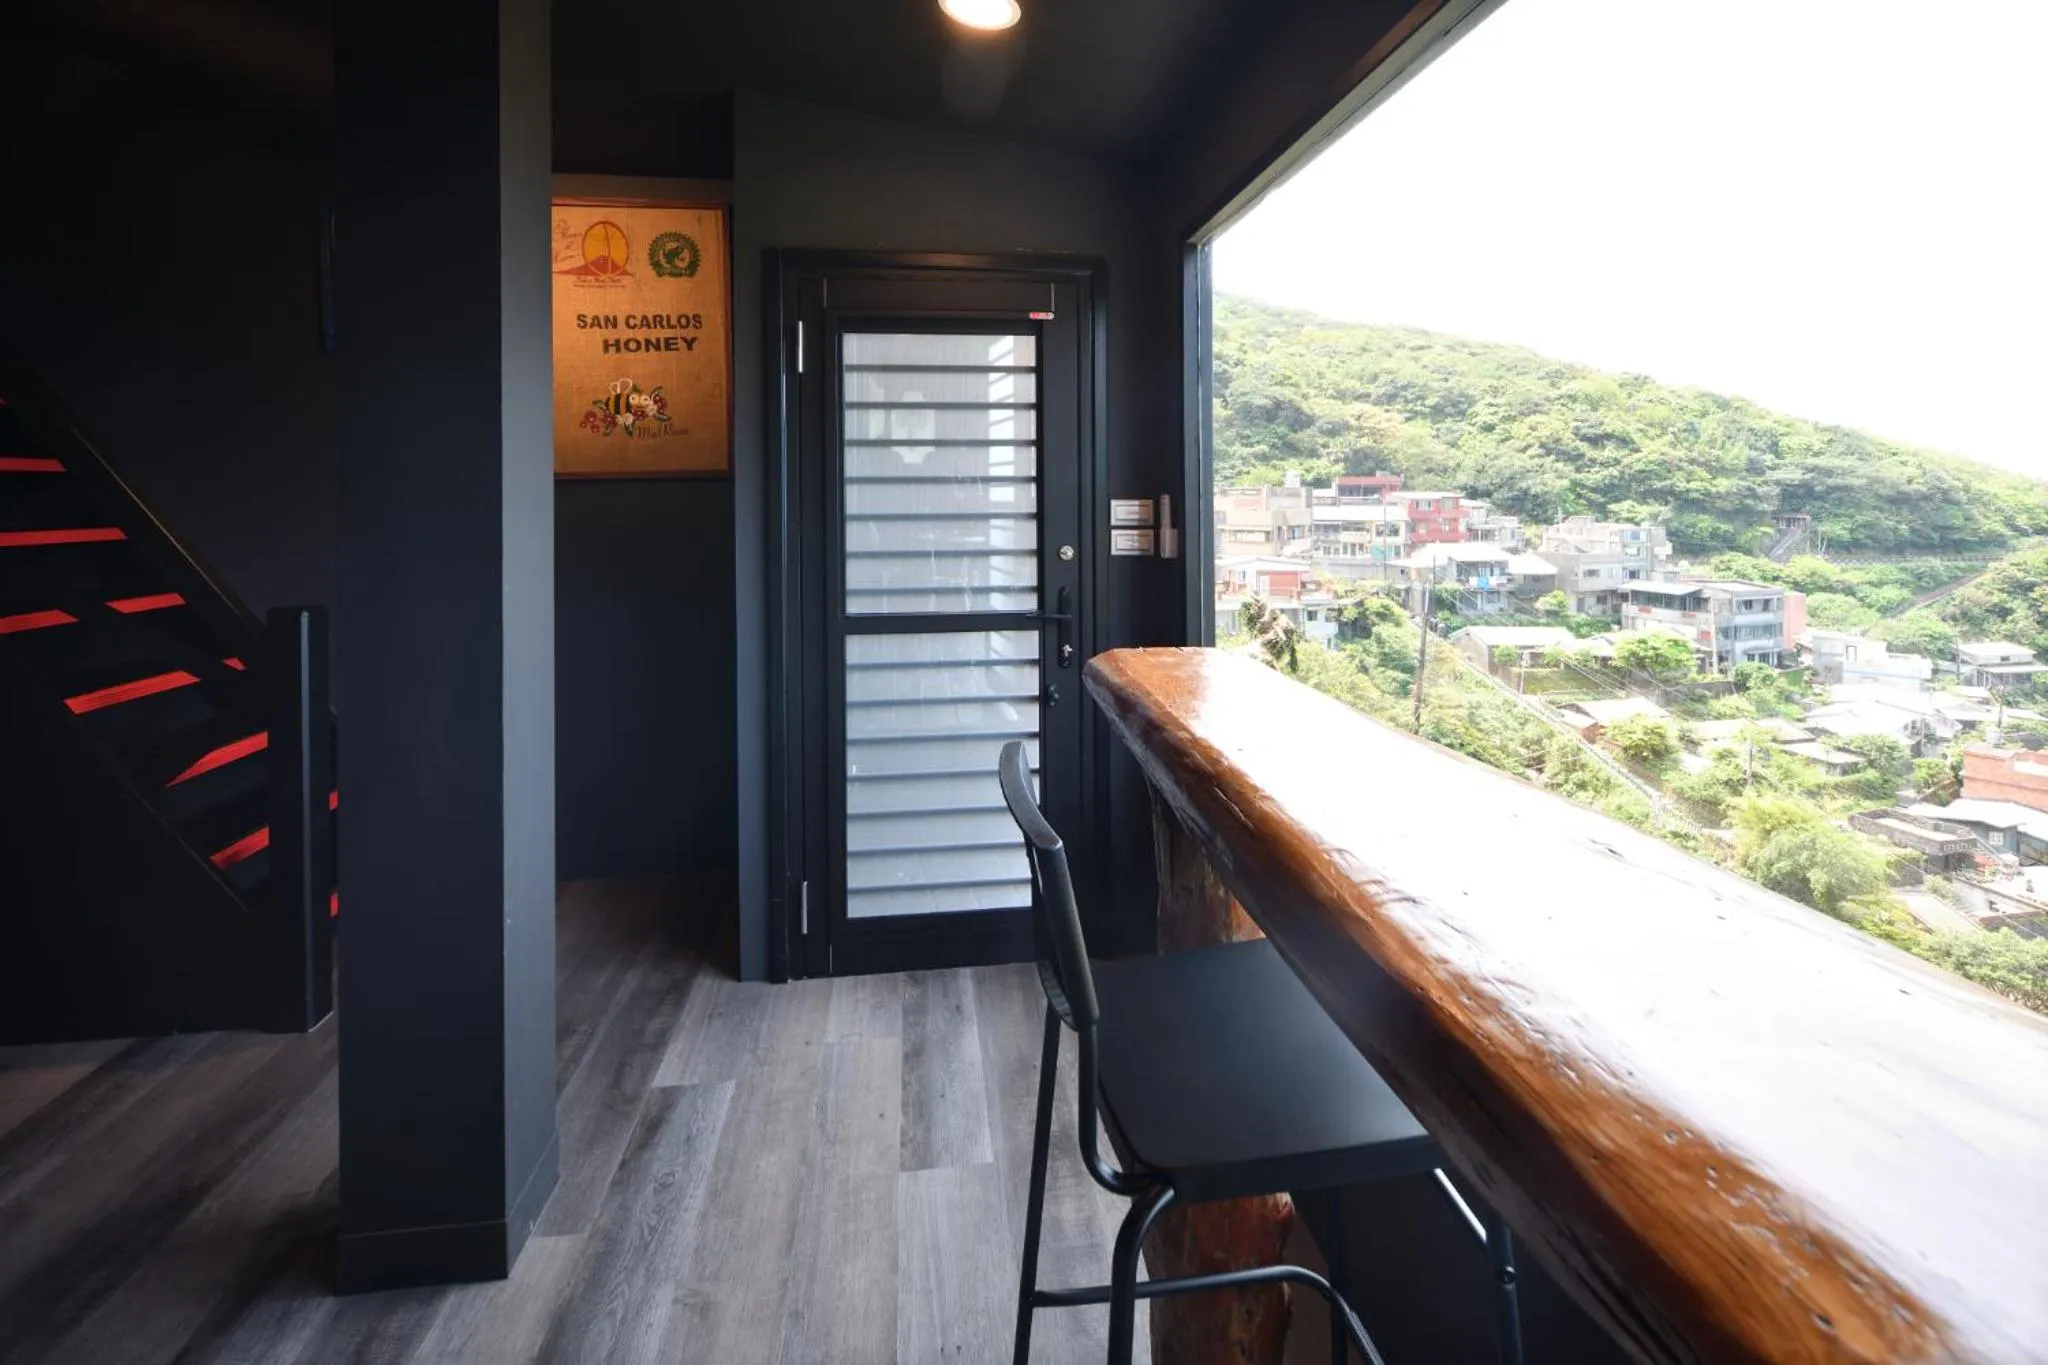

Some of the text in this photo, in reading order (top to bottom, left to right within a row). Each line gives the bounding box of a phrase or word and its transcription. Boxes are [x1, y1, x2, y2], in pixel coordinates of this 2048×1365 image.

[576, 313, 703, 330] SAN CARLOS
[602, 336, 699, 354] HONEY
